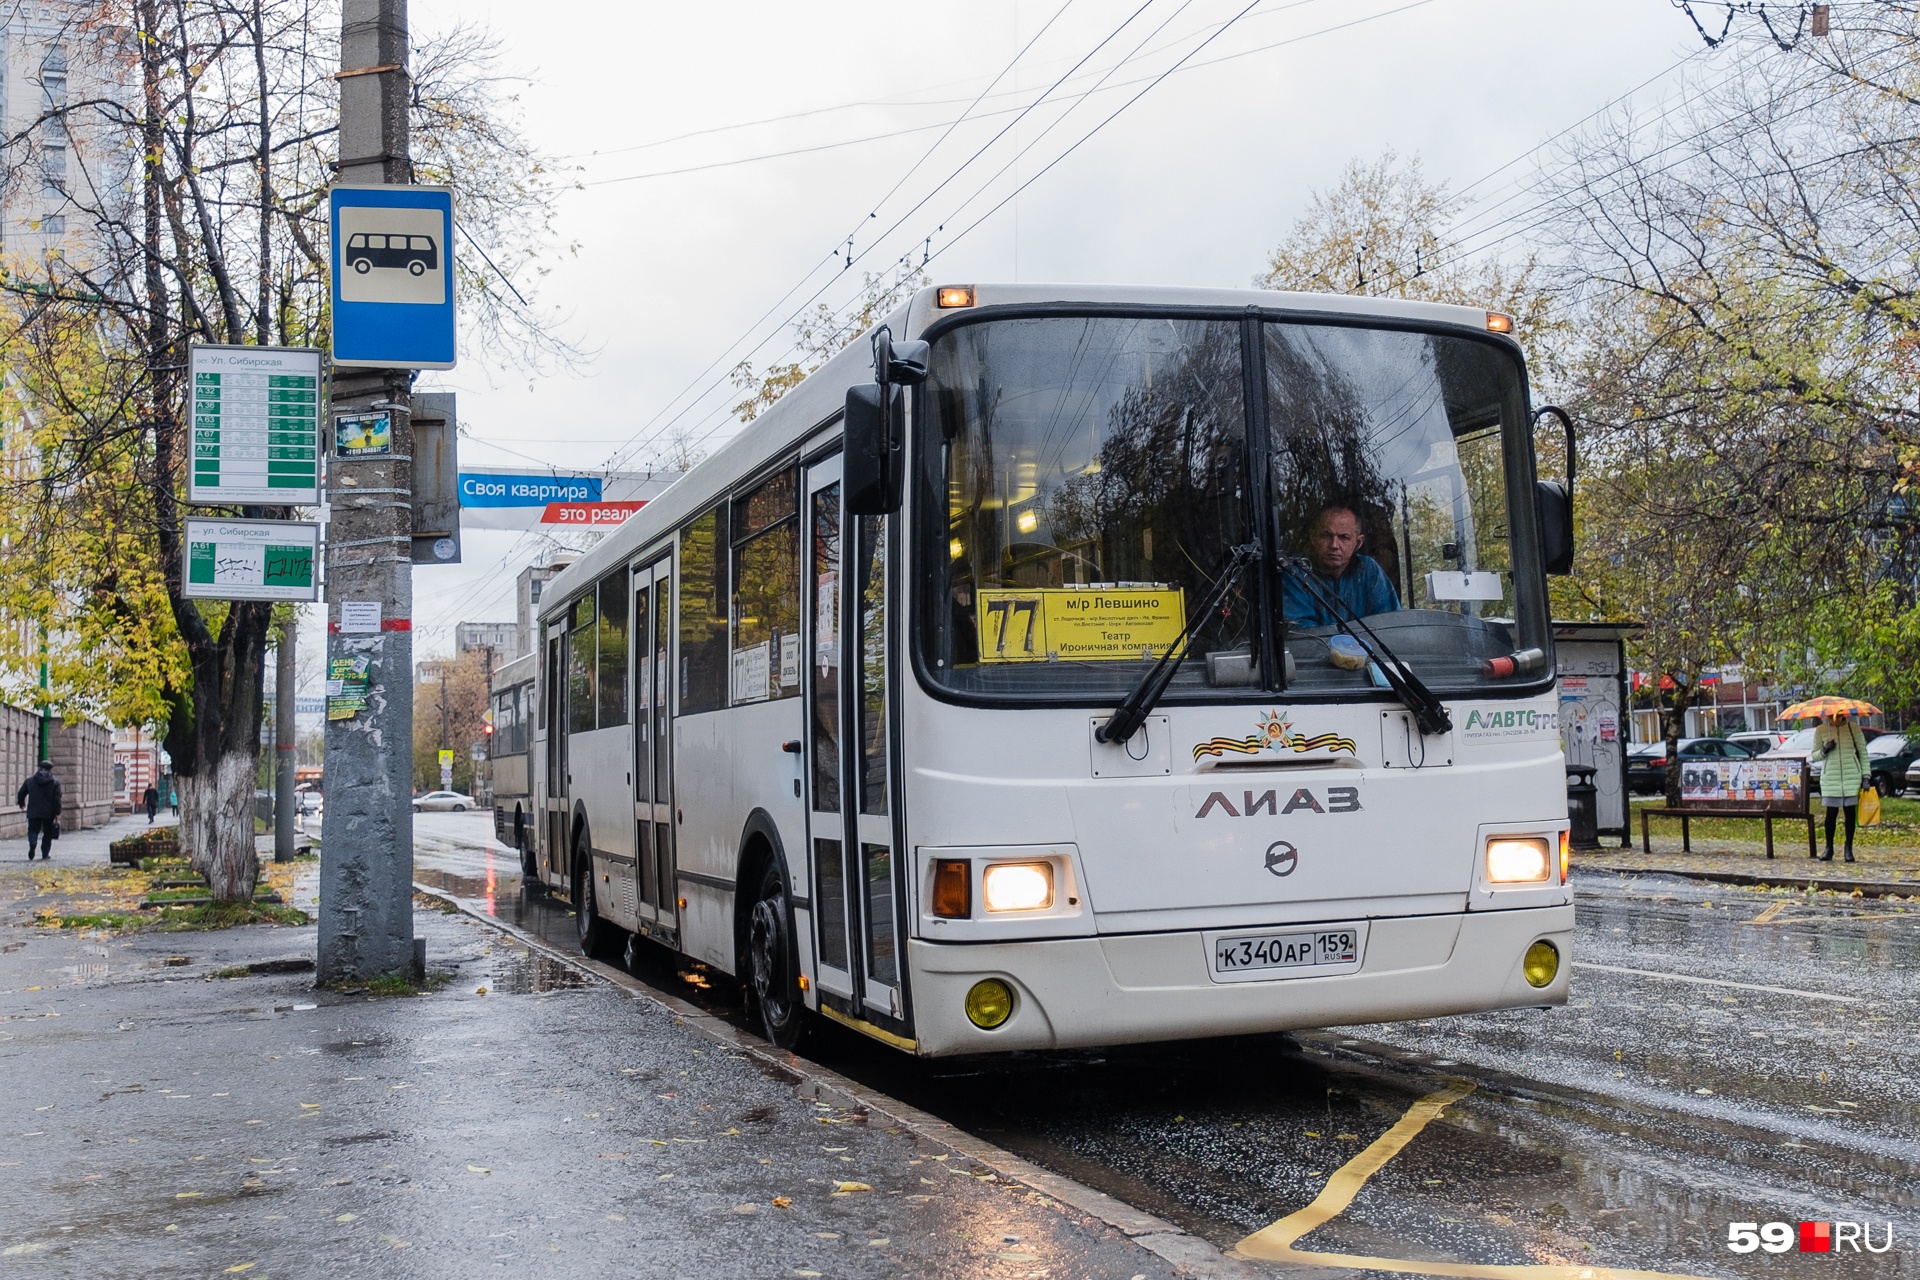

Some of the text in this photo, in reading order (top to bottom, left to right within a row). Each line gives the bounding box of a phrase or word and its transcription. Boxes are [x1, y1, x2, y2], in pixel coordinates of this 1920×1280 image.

[211, 356, 226, 365] Ул.
[228, 356, 283, 368] Сибирская
[463, 480, 588, 502] Своя квартира
[559, 508, 586, 521] это
[203, 527, 216, 536] ул.
[219, 527, 270, 538] Сибирская
[1066, 597, 1160, 612] м/р Левшино
[986, 599, 1038, 652] 77
[1100, 631, 1131, 641] Театр
[1060, 642, 1172, 652] Ироничная компания
[1194, 786, 1360, 819] ЛИАЗ
[1317, 933, 1350, 953] 159
[1324, 952, 1341, 961] RUS
